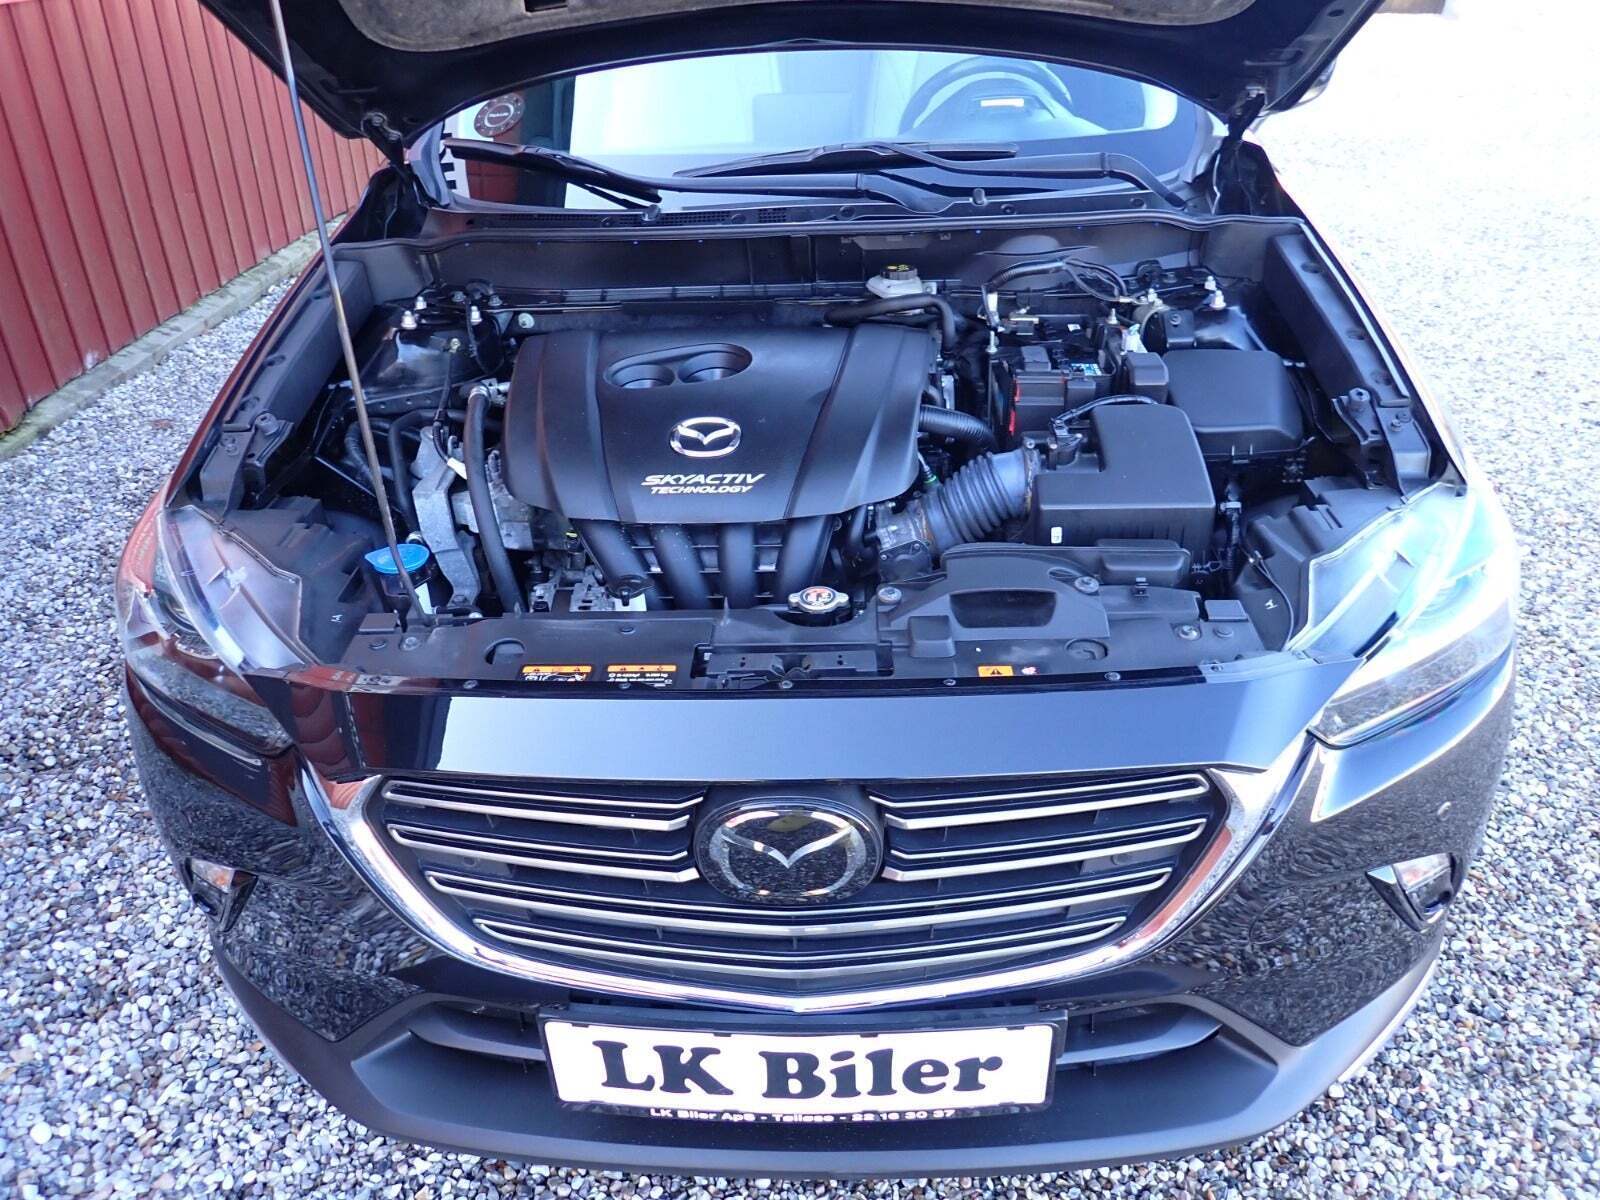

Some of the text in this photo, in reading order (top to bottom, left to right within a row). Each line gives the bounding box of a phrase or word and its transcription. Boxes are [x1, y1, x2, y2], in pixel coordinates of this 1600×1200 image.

[640, 473, 766, 485] SKYACTIV
[650, 485, 753, 494] TECHNOLOGY
[592, 1040, 1003, 1099] LK Biler
[650, 1108, 673, 1118] LK
[677, 1109, 717, 1119] Biler
[905, 1110, 928, 1119] 30
[933, 1109, 956, 1118] 37
